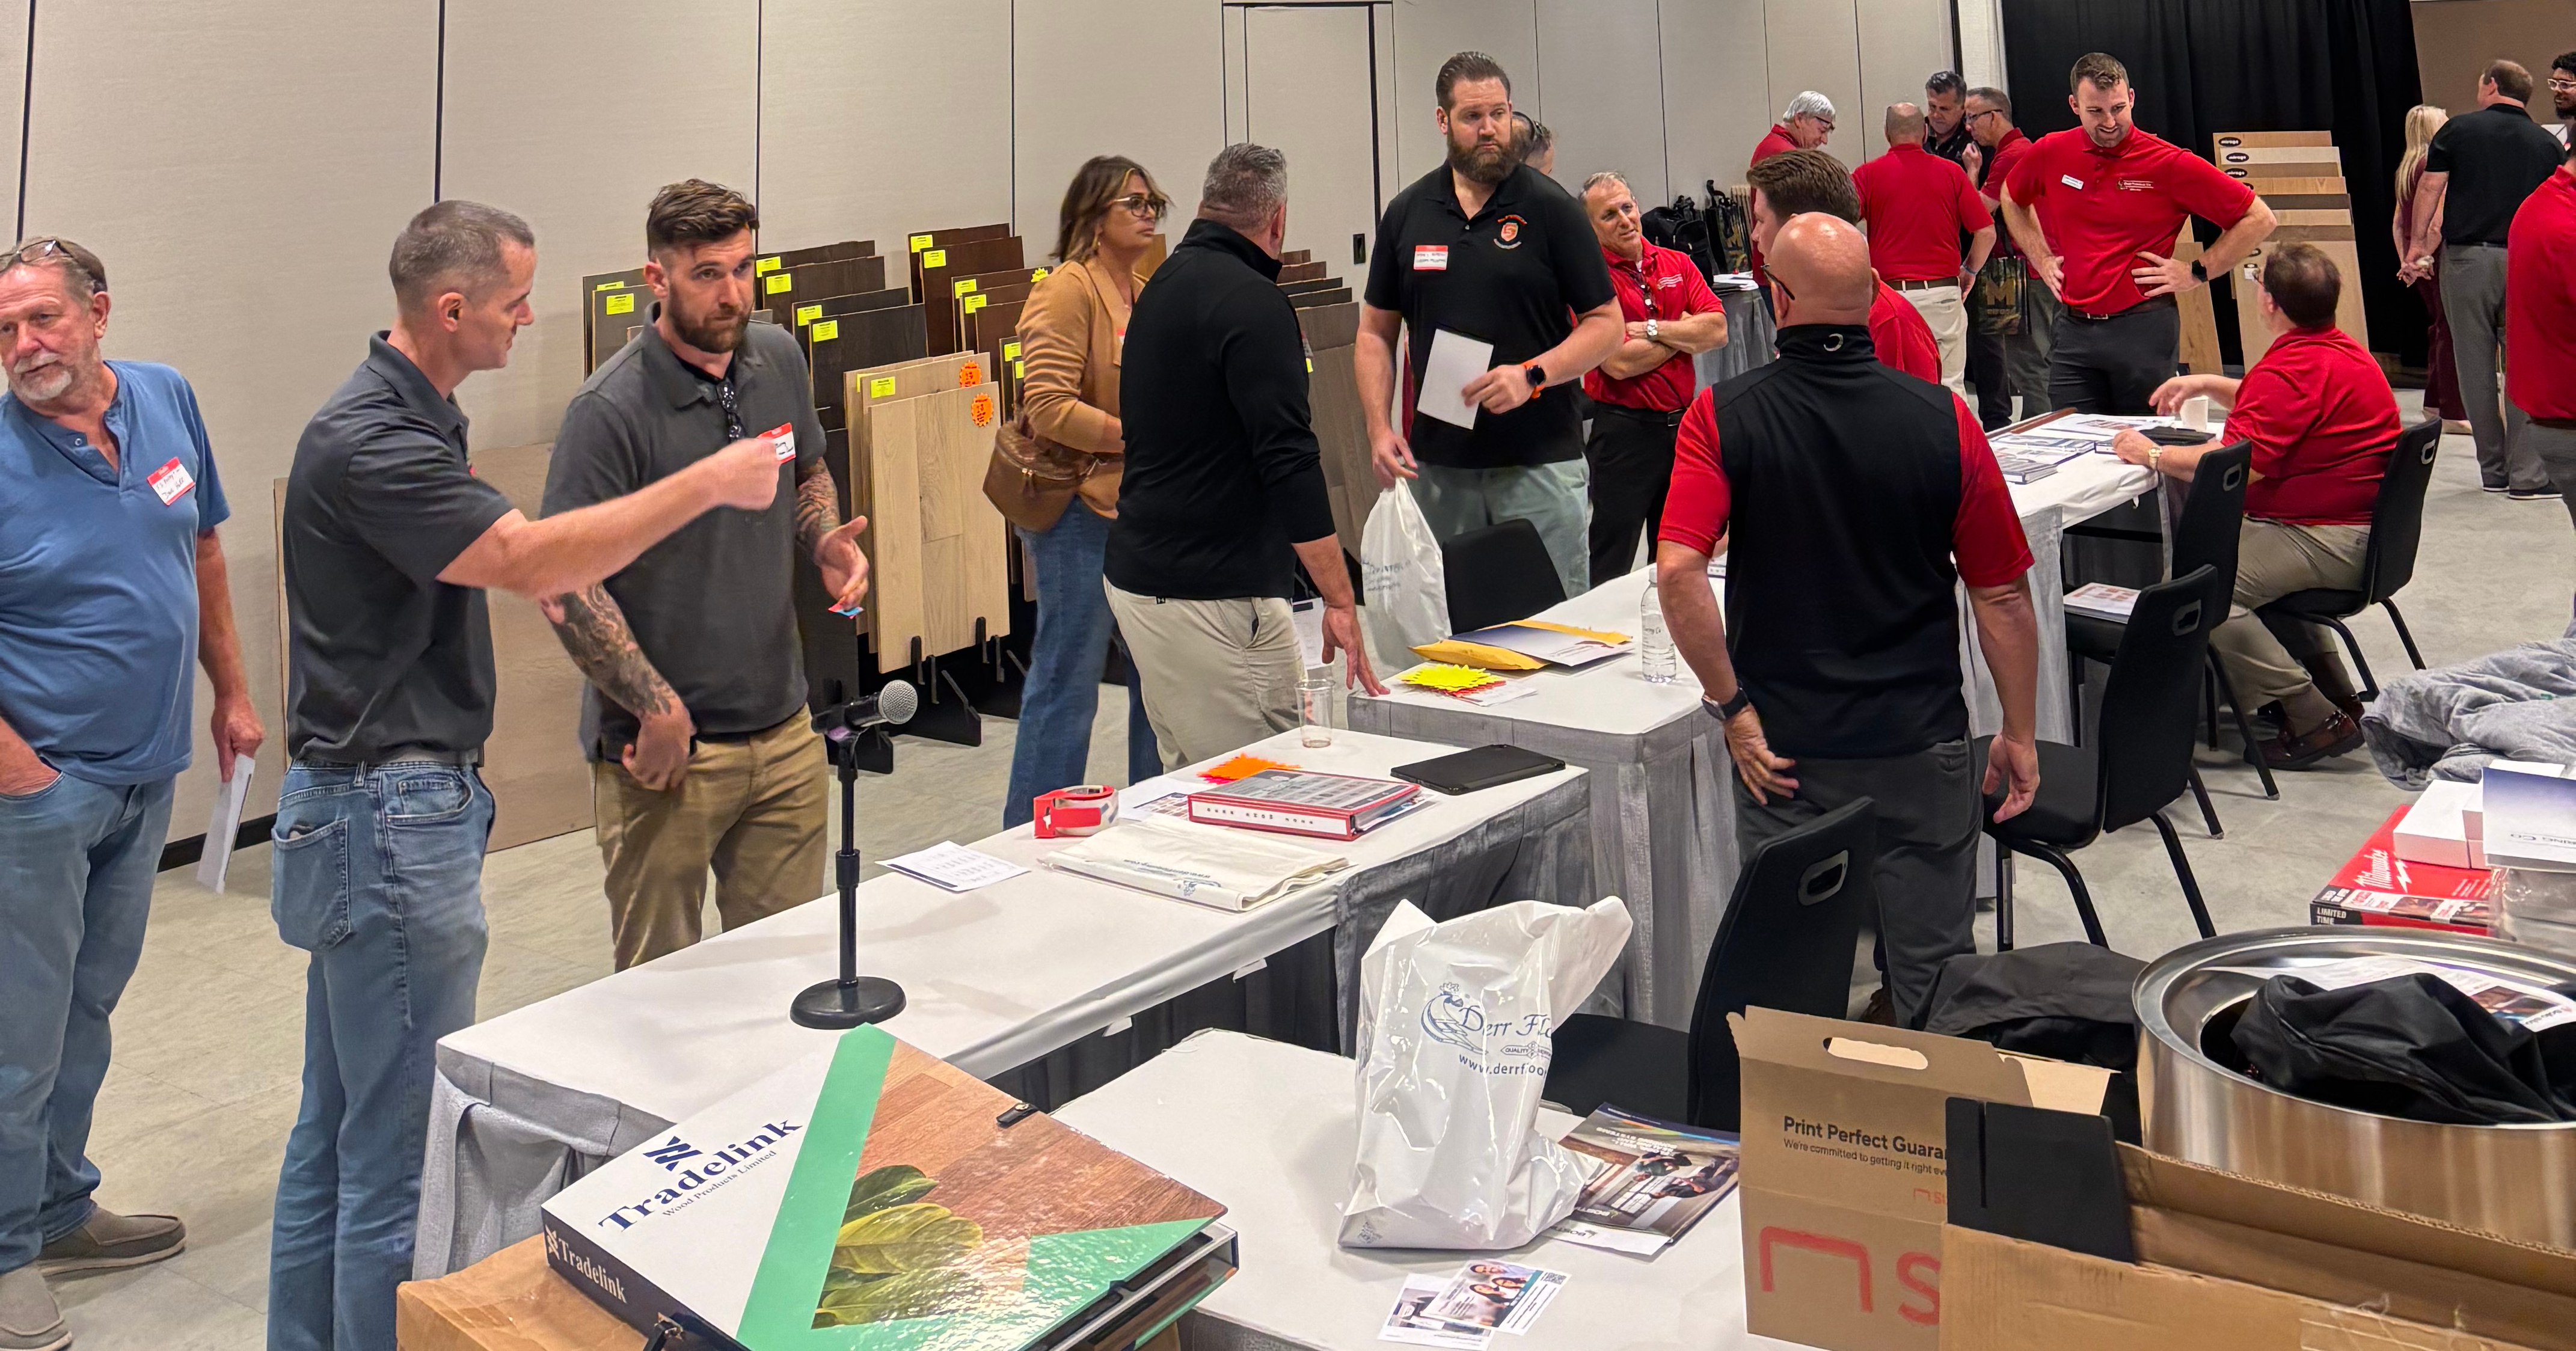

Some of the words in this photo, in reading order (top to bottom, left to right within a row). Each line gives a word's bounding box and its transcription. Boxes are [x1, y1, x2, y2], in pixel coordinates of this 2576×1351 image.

[2353, 848, 2394, 890] Milwaukee
[2316, 907, 2346, 919] LIMITED
[1458, 1005, 1513, 1037] Derr
[1459, 1054, 1547, 1077] www.derrfoo
[1783, 1115, 1823, 1138] Print
[1827, 1123, 1889, 1150] Perfect
[1783, 1138, 1809, 1152] We're
[1810, 1145, 1857, 1160] committed
[1859, 1153, 1868, 1162] to
[1870, 1156, 1902, 1171] getting
[1903, 1159, 1910, 1169] it
[1911, 1163, 1933, 1174] right
[598, 1119, 803, 1233] Tradelink
[661, 1196, 695, 1217] Wood
[694, 1173, 739, 1200] Products
[737, 1150, 777, 1175] Limited
[559, 1240, 628, 1304] Tradelink
